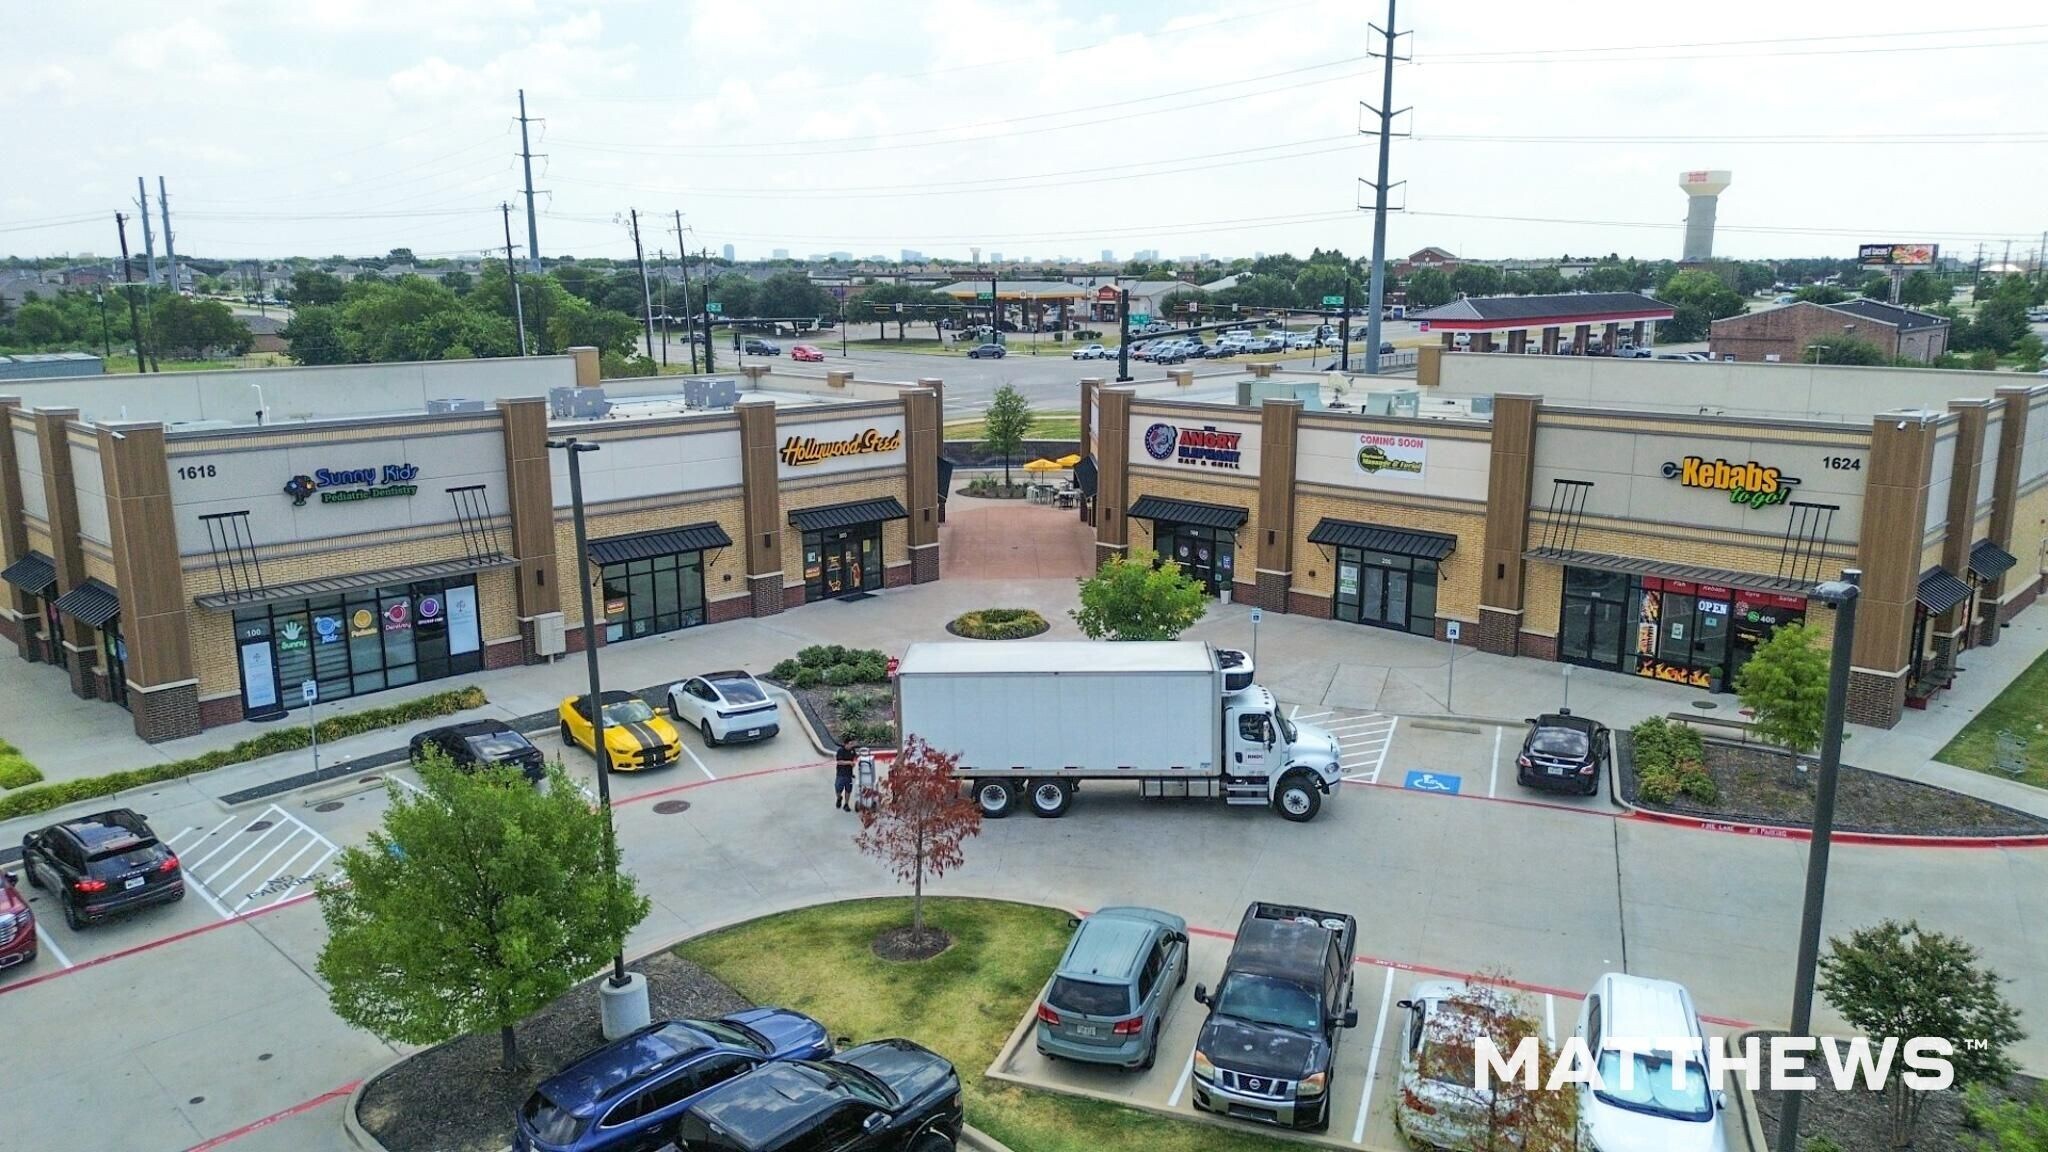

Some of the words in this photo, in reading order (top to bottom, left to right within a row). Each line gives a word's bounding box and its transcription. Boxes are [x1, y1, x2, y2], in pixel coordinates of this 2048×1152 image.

[780, 433, 860, 466] Hollywood
[860, 428, 901, 453] Feed
[1179, 431, 1241, 450] ANGRY
[1360, 435, 1395, 446] COMING
[1398, 438, 1424, 448] SOON
[1823, 456, 1861, 470] 1624
[177, 465, 217, 480] 1618
[315, 467, 376, 488] Sunny
[381, 464, 419, 484] Kids
[1681, 456, 1781, 493] Kebabs
[322, 488, 370, 503] Pediatric
[372, 485, 418, 499] Dentistry
[1730, 486, 1750, 504] to
[1750, 487, 1792, 509] go!
[1698, 600, 1728, 615] OPEN
[1760, 615, 1776, 624] 400
[247, 628, 261, 637] 100
[281, 639, 307, 651] Sunny
